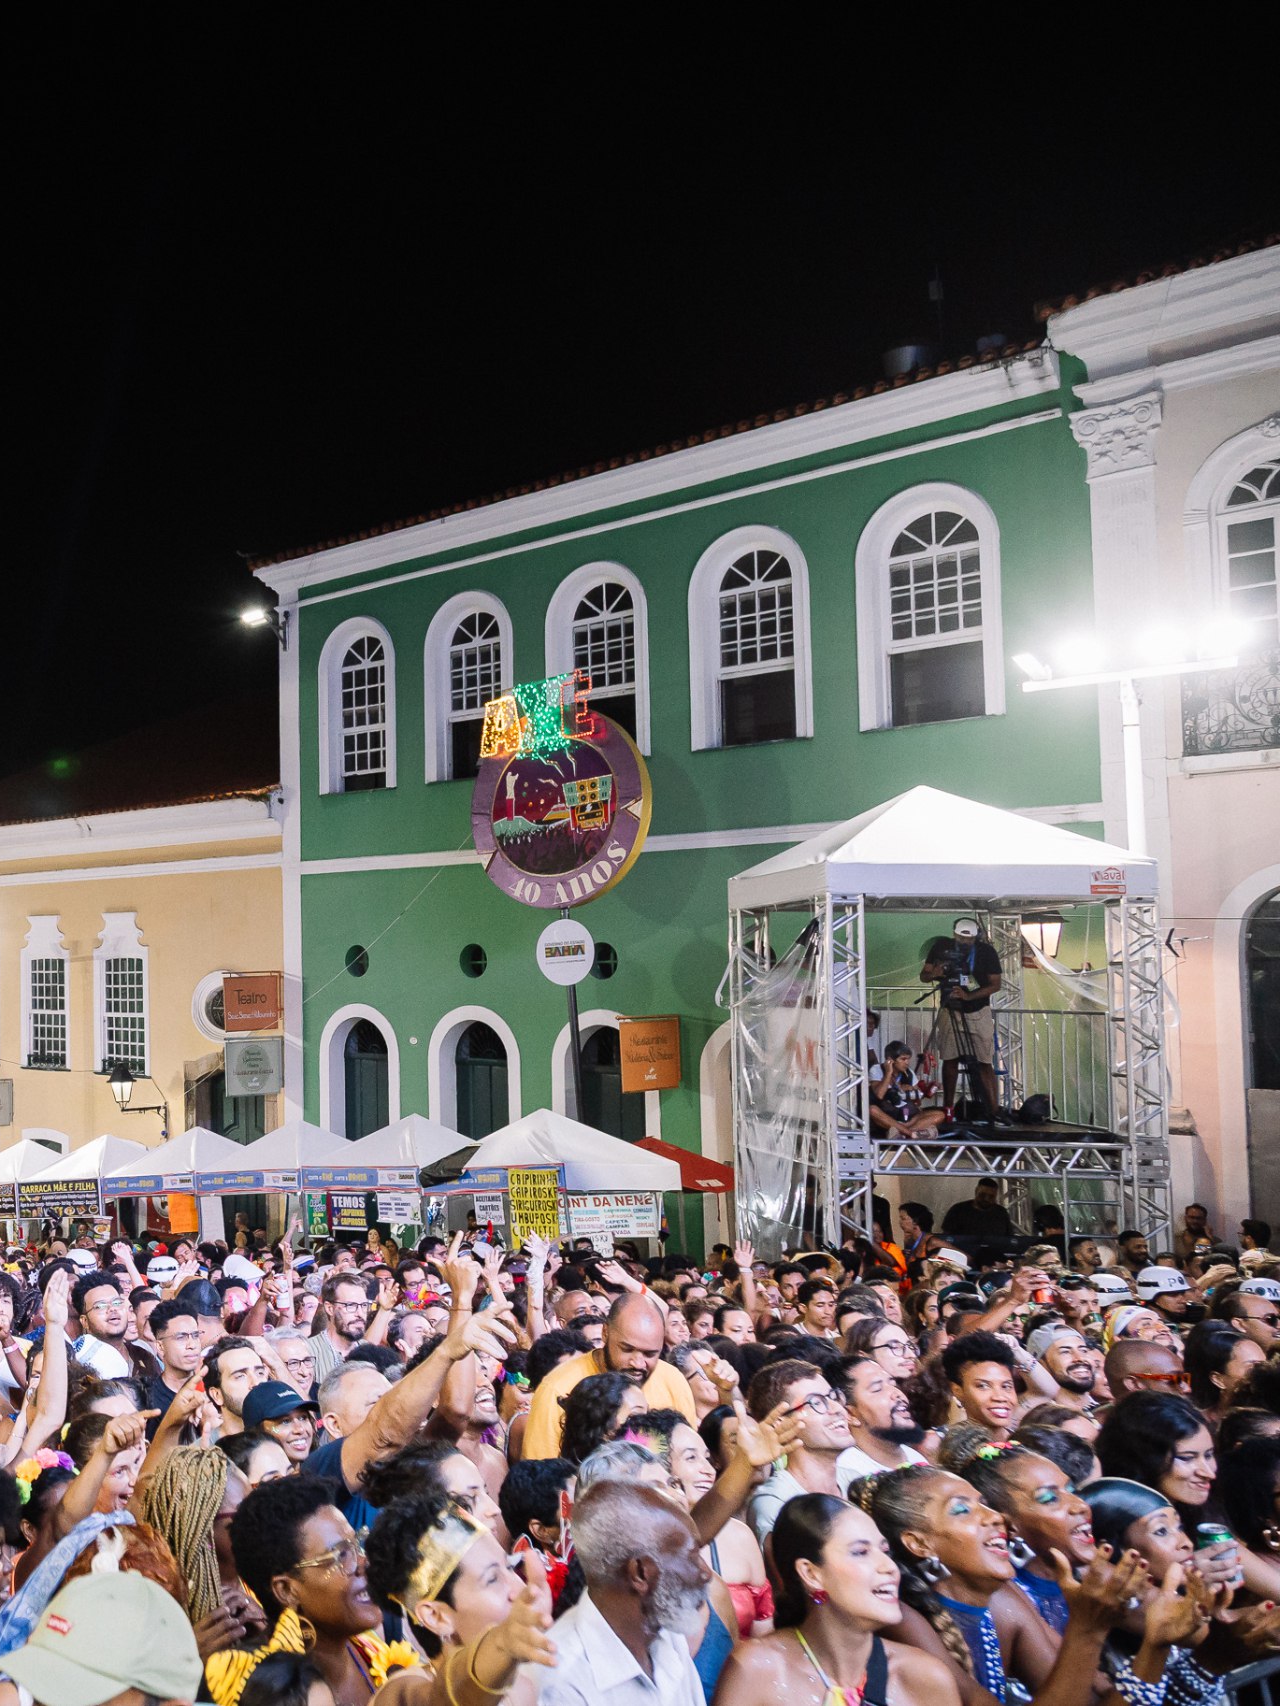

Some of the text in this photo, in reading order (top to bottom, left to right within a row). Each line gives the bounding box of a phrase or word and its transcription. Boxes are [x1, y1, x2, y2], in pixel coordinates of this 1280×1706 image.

[508, 840, 628, 907] 40 ANOS
[233, 988, 268, 1005] Teatro
[21, 1182, 96, 1194] BARRACA MÃE E FILHA
[332, 1195, 365, 1208] TEMOS
[593, 1196, 611, 1207] DA
